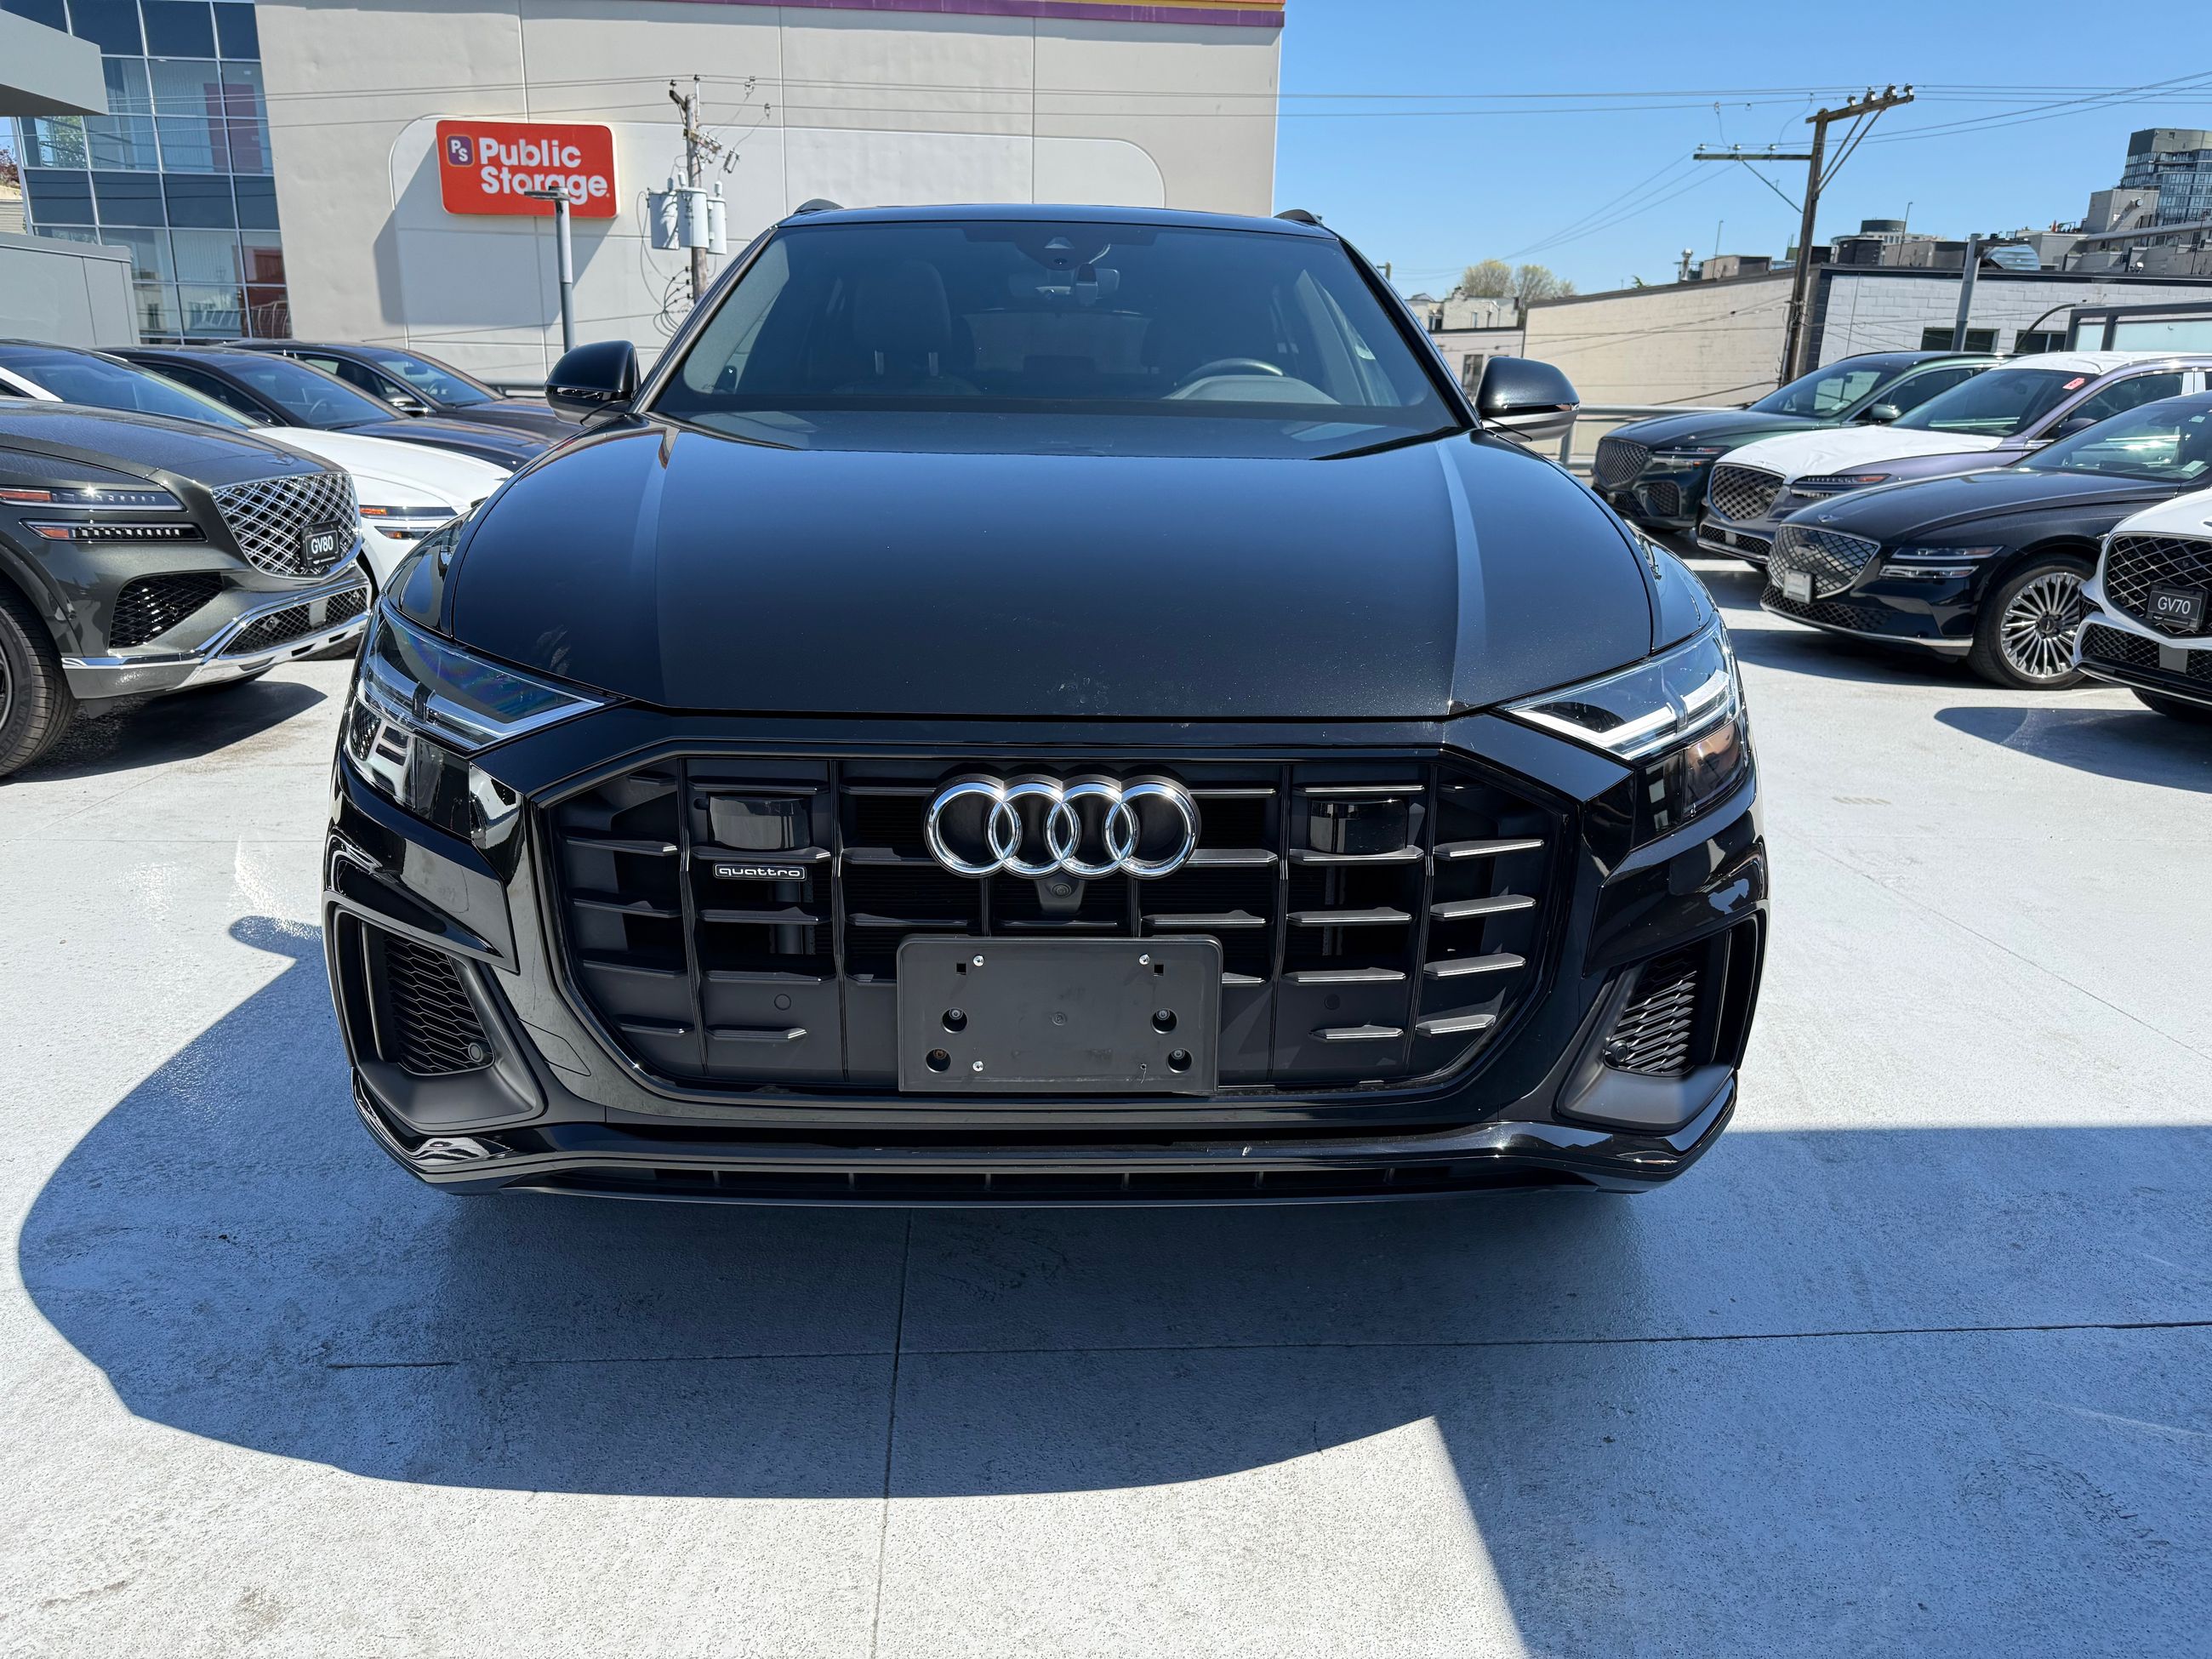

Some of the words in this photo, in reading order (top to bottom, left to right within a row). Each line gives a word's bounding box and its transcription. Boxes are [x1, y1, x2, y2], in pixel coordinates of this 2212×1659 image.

[479, 137, 582, 168] Public
[481, 166, 607, 206] Storage
[311, 535, 334, 555] GV80
[2158, 596, 2191, 614] GV70
[719, 868, 801, 876] quattro
